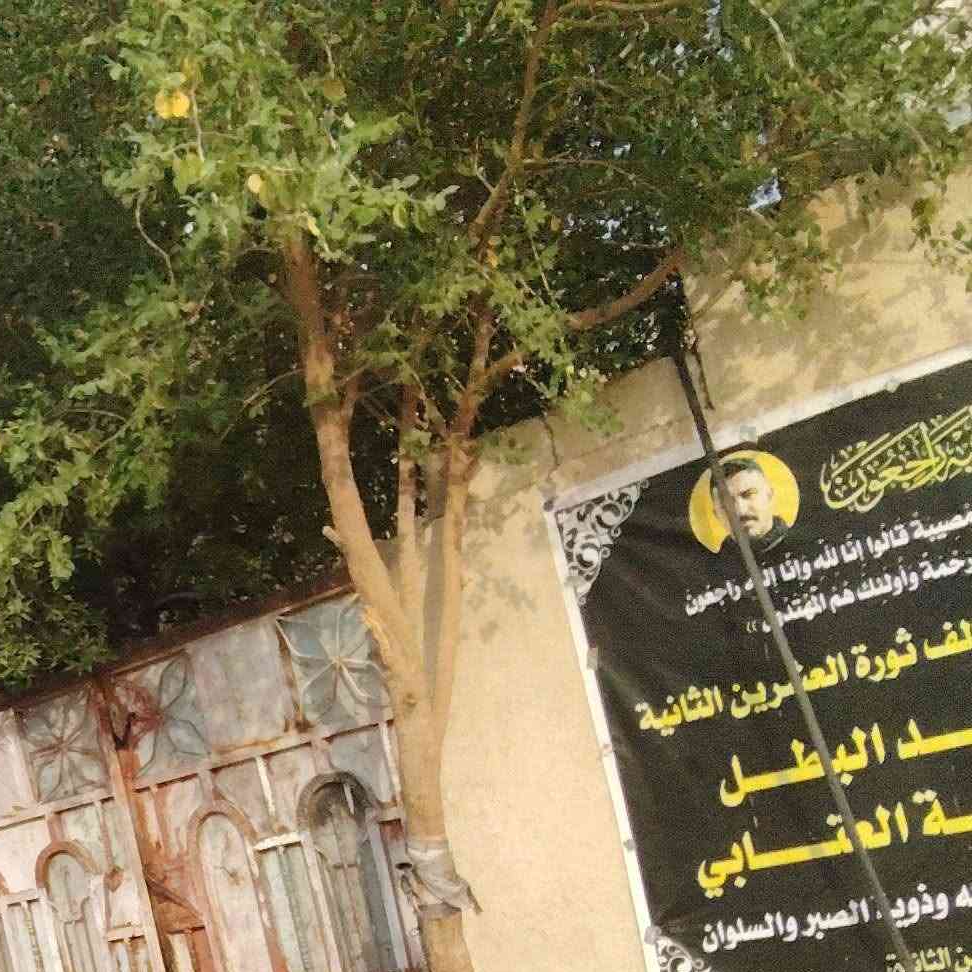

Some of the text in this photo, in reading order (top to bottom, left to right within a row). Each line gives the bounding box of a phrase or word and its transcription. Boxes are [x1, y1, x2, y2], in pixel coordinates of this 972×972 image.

[851, 626, 918, 682] ثورة
[923, 618, 972, 661] لف
[634, 684, 724, 737] الثانية
[702, 910, 799, 954] والسلوان
[800, 896, 870, 941] الصبر
